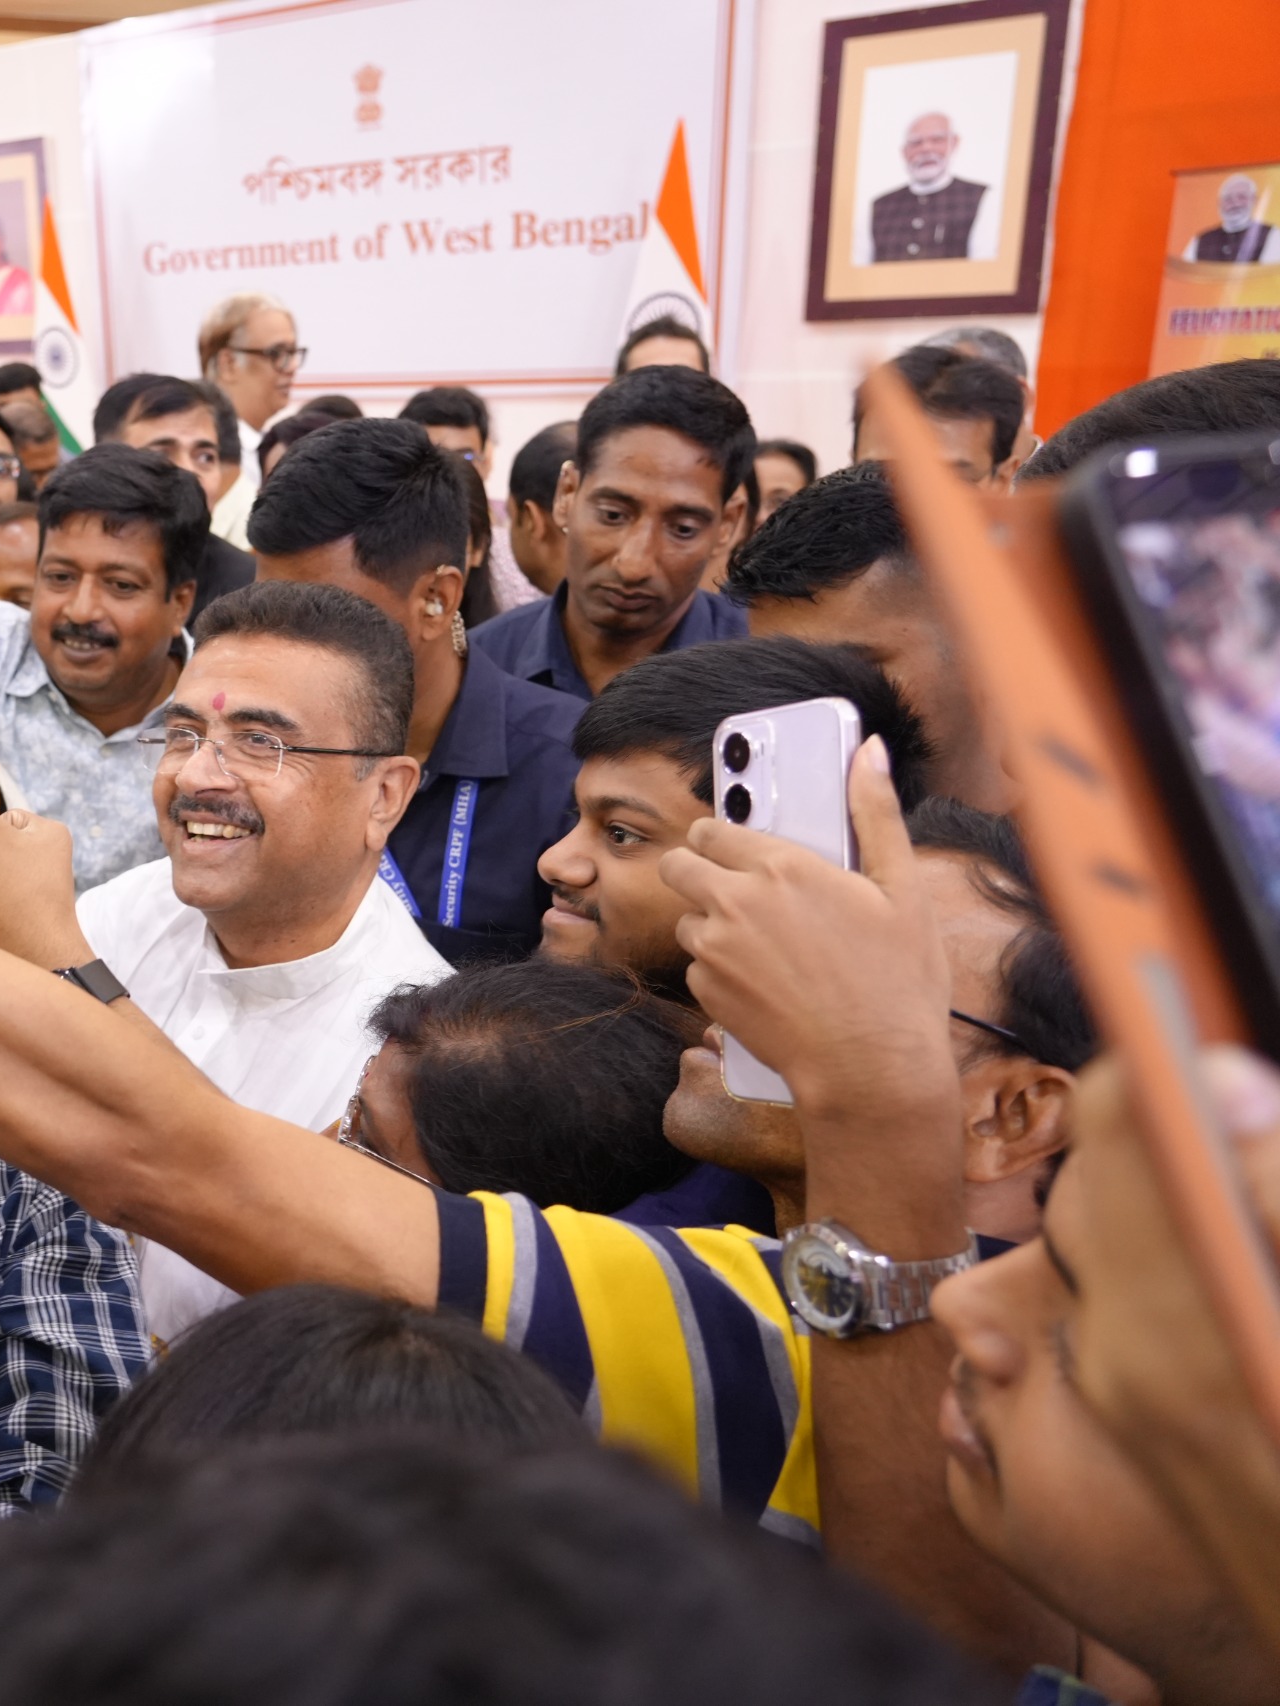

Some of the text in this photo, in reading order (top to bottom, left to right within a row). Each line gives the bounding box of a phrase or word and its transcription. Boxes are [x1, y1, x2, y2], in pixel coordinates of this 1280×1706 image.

[242, 146, 512, 204] পশ্চিমবঙ্গ সরকার
[143, 201, 650, 276] Government of West Bengal
[448, 827, 465, 868] CRPF
[442, 871, 462, 927] Security
